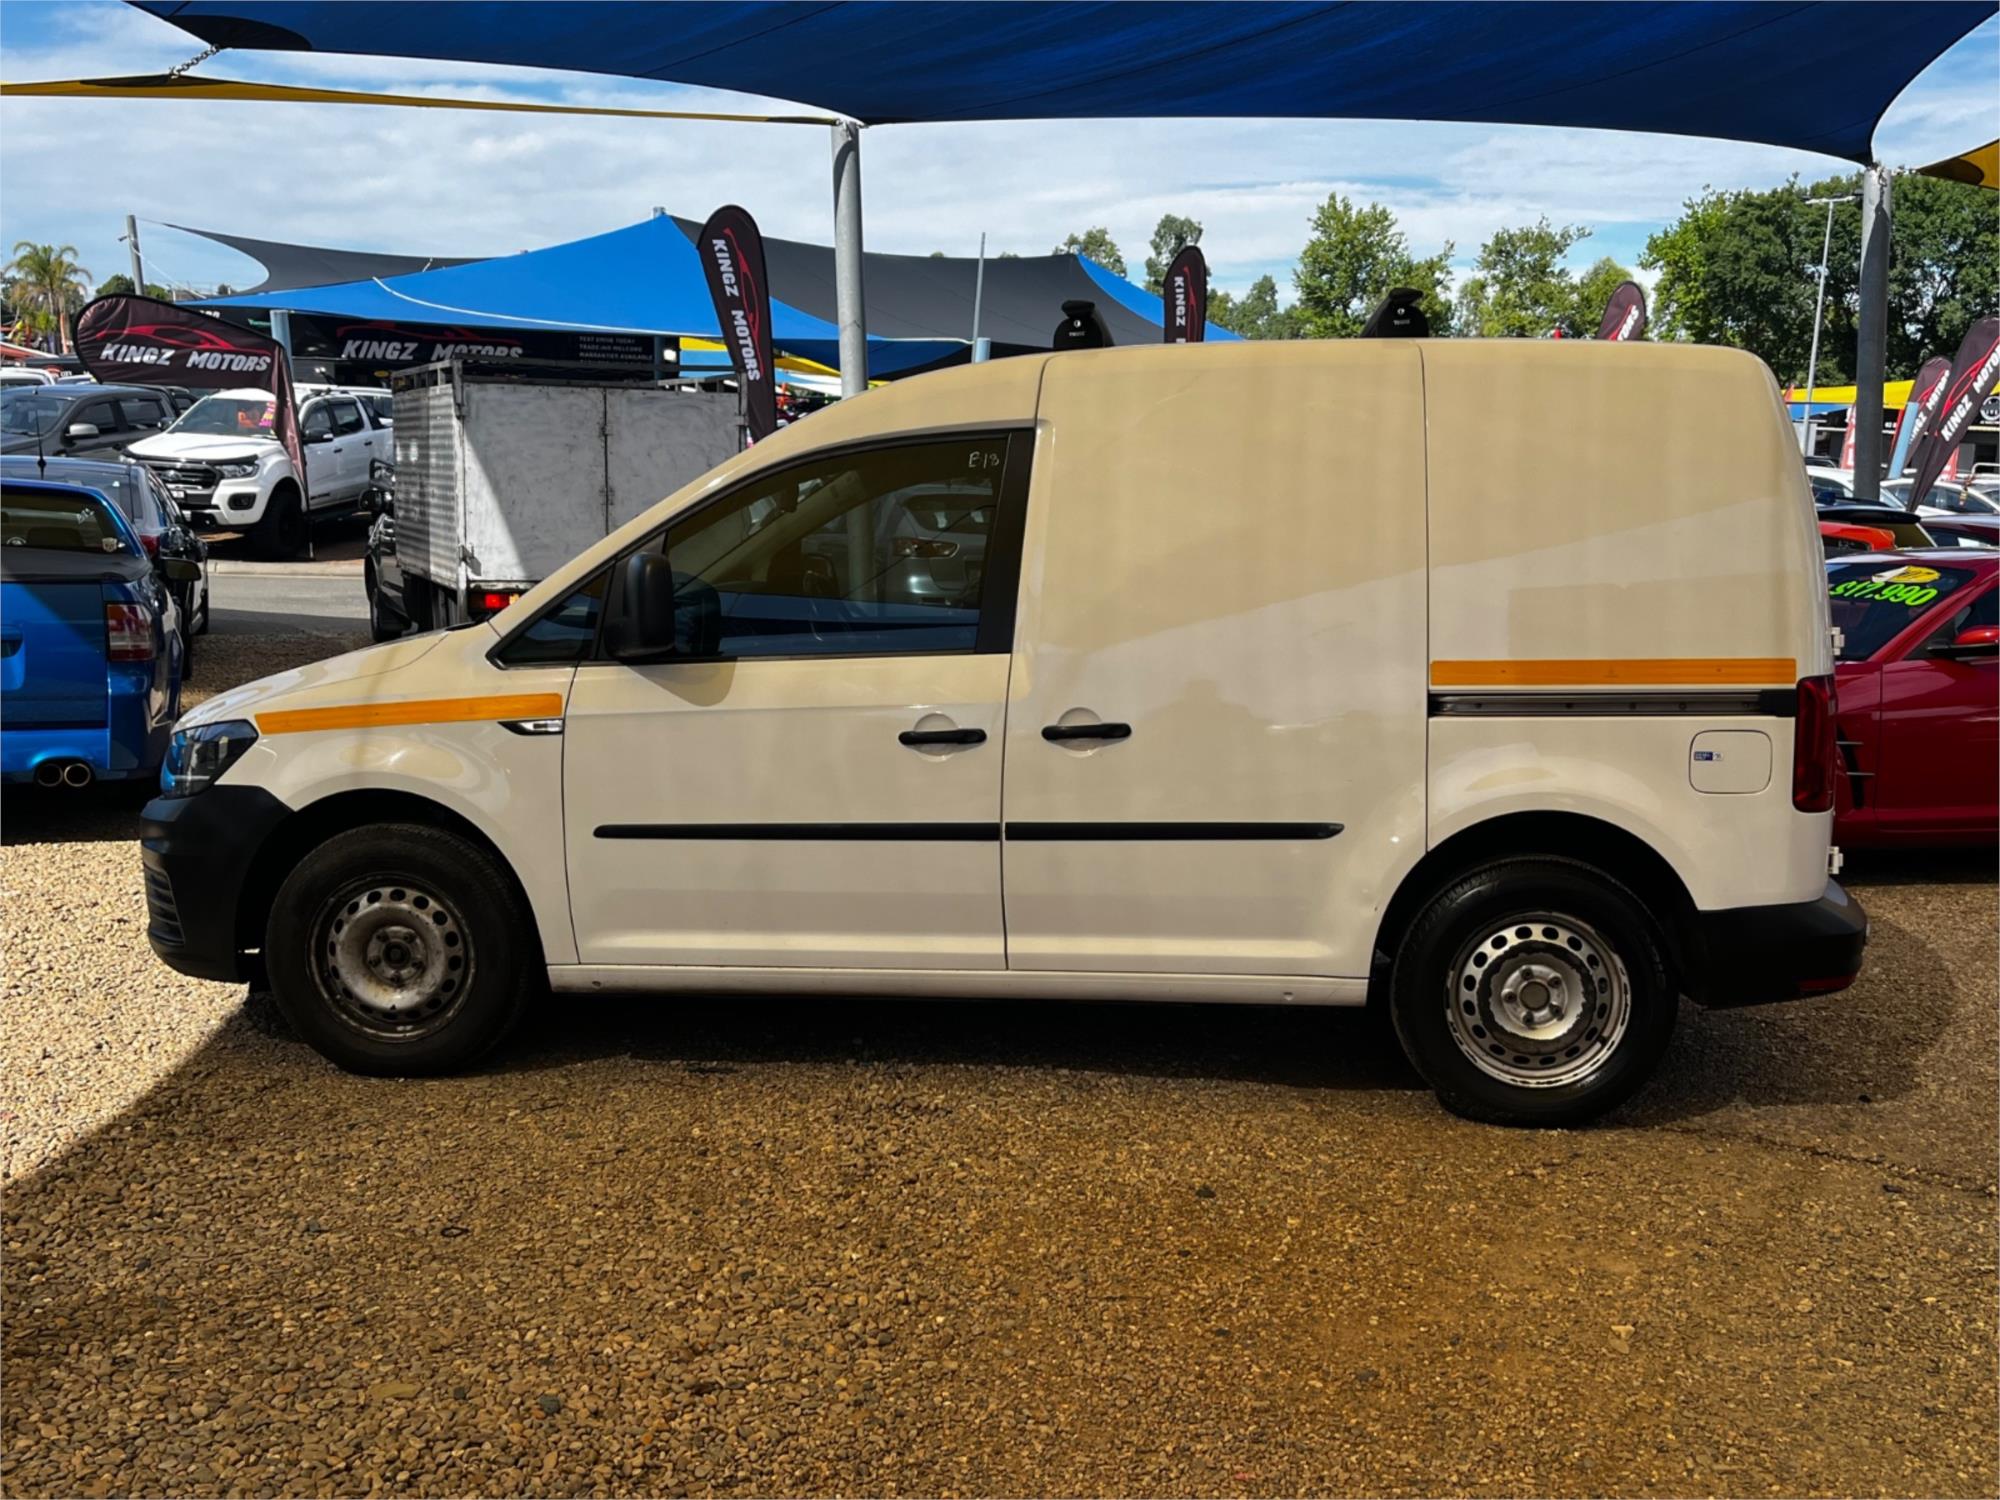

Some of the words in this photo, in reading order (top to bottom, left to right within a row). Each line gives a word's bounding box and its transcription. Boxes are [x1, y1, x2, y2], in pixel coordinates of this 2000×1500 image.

[712, 239, 739, 297] KINGZ
[731, 310, 761, 382] MOTORS
[1174, 276, 1186, 327] KINGZ
[100, 343, 176, 366] KINGZ
[186, 350, 272, 372] MOTORS
[342, 340, 419, 361] KINGZ
[1940, 393, 1973, 442] KINGZ
[1972, 343, 2000, 394] MOTO
